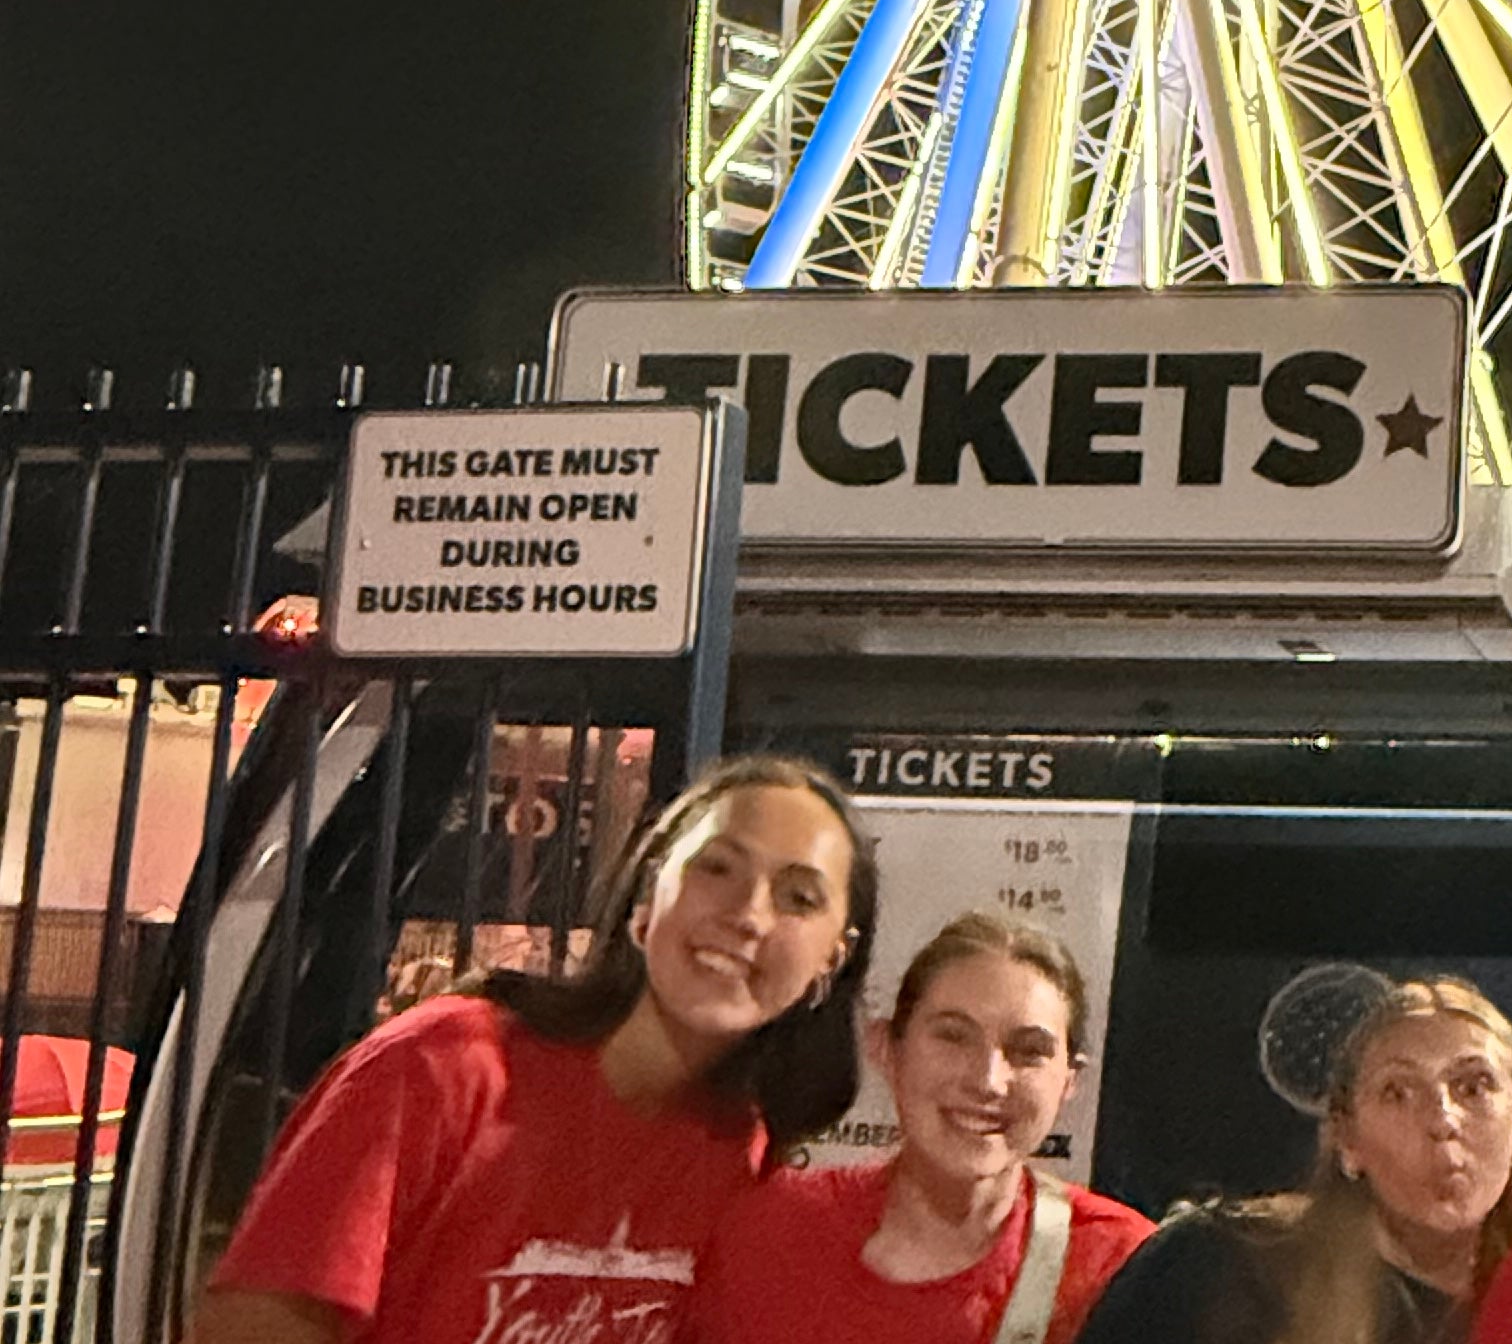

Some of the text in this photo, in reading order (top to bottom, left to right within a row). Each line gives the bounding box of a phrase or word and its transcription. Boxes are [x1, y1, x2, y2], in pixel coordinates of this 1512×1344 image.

[636, 351, 1367, 488] TICKETS
[381, 448, 660, 478] THIS GATE MUST
[392, 492, 638, 523] REMAIN OPEN
[440, 539, 580, 568] DURING
[356, 584, 658, 613] BUSINESS HOURS
[847, 748, 1055, 791] TICKETS
